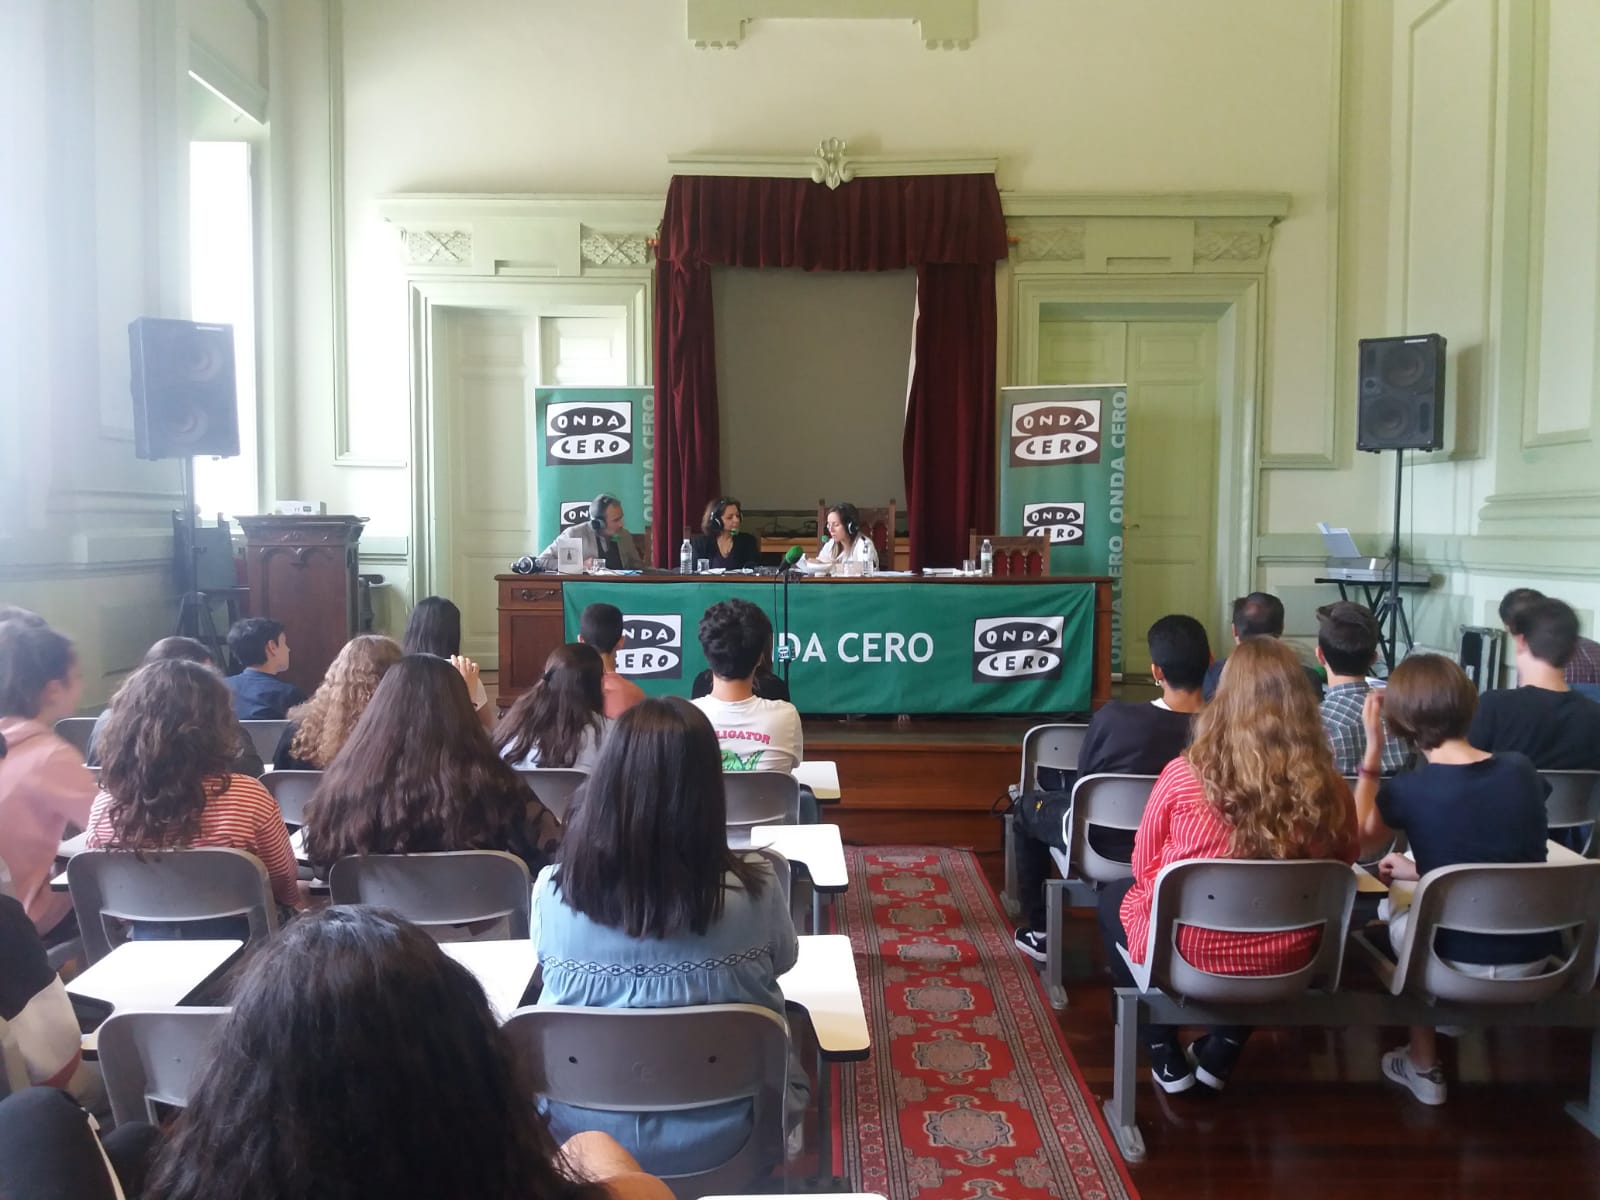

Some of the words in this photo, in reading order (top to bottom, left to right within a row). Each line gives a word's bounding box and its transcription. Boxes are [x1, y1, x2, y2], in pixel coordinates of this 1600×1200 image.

[557, 414, 619, 429] ONDA
[642, 394, 655, 450] CERO
[1023, 414, 1087, 429] ONDA
[1111, 391, 1126, 449] CERO
[561, 439, 620, 454] CERO
[1026, 439, 1087, 455] CERO
[643, 460, 654, 522] ONDA
[1109, 455, 1125, 523] ONDA
[568, 509, 589, 520] ON
[1031, 511, 1076, 522] ONDA
[1033, 528, 1075, 539] CRO
[622, 627, 668, 640] NDA
[986, 629, 1050, 645] ONDA
[772, 632, 827, 663] DA
[837, 632, 934, 664] CERO
[615, 653, 669, 668] ERO
[989, 655, 1049, 671] CERO
[714, 730, 771, 744] LIGATOR
